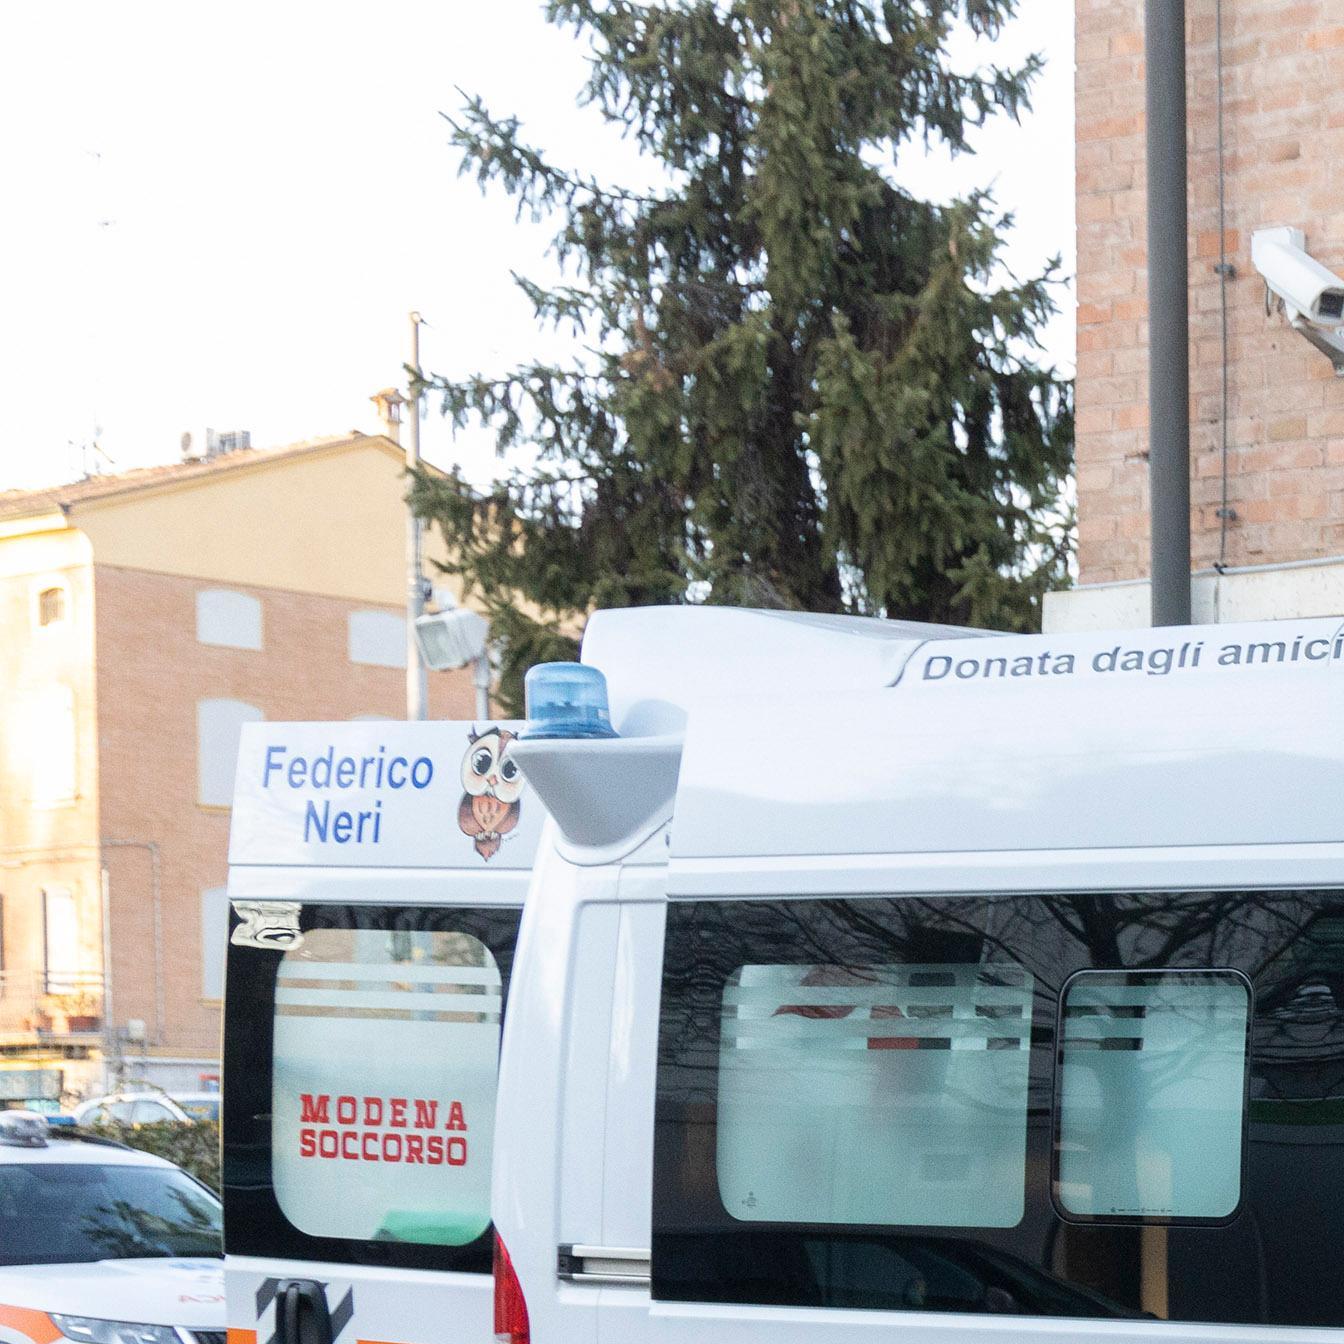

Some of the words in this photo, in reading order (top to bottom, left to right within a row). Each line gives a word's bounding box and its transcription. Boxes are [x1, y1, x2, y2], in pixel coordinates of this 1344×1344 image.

[922, 649, 1075, 681] Donata
[1091, 640, 1203, 676] dagli
[1217, 632, 1344, 666] amici
[261, 743, 435, 790] Federico
[303, 800, 382, 844] Neri
[300, 1094, 467, 1131] MODENA
[300, 1129, 467, 1166] SOCCORSO
